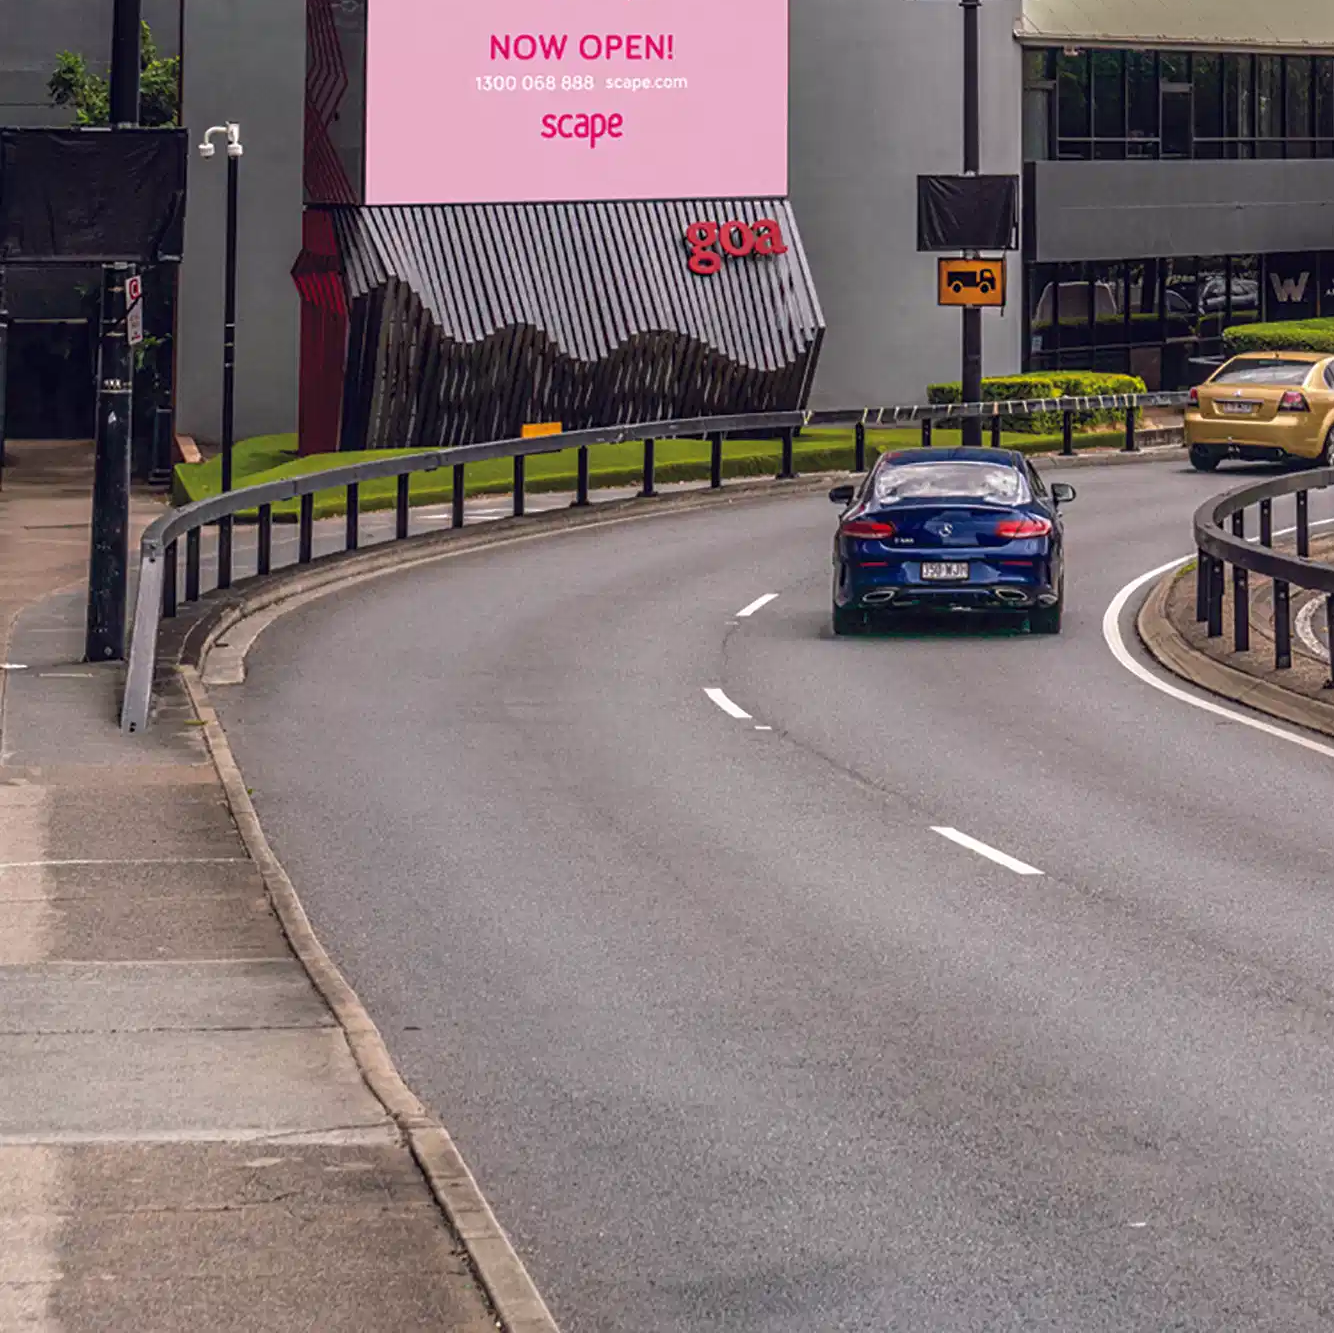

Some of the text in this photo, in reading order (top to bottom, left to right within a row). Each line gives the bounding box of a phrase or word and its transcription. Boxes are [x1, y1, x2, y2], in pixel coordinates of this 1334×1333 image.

[490, 34, 674, 61] NOW OPEN!
[475, 75, 688, 92] 1300 068 888 scape.com
[541, 112, 624, 149] scape
[686, 218, 788, 275] goa
[1269, 271, 1310, 302] W
